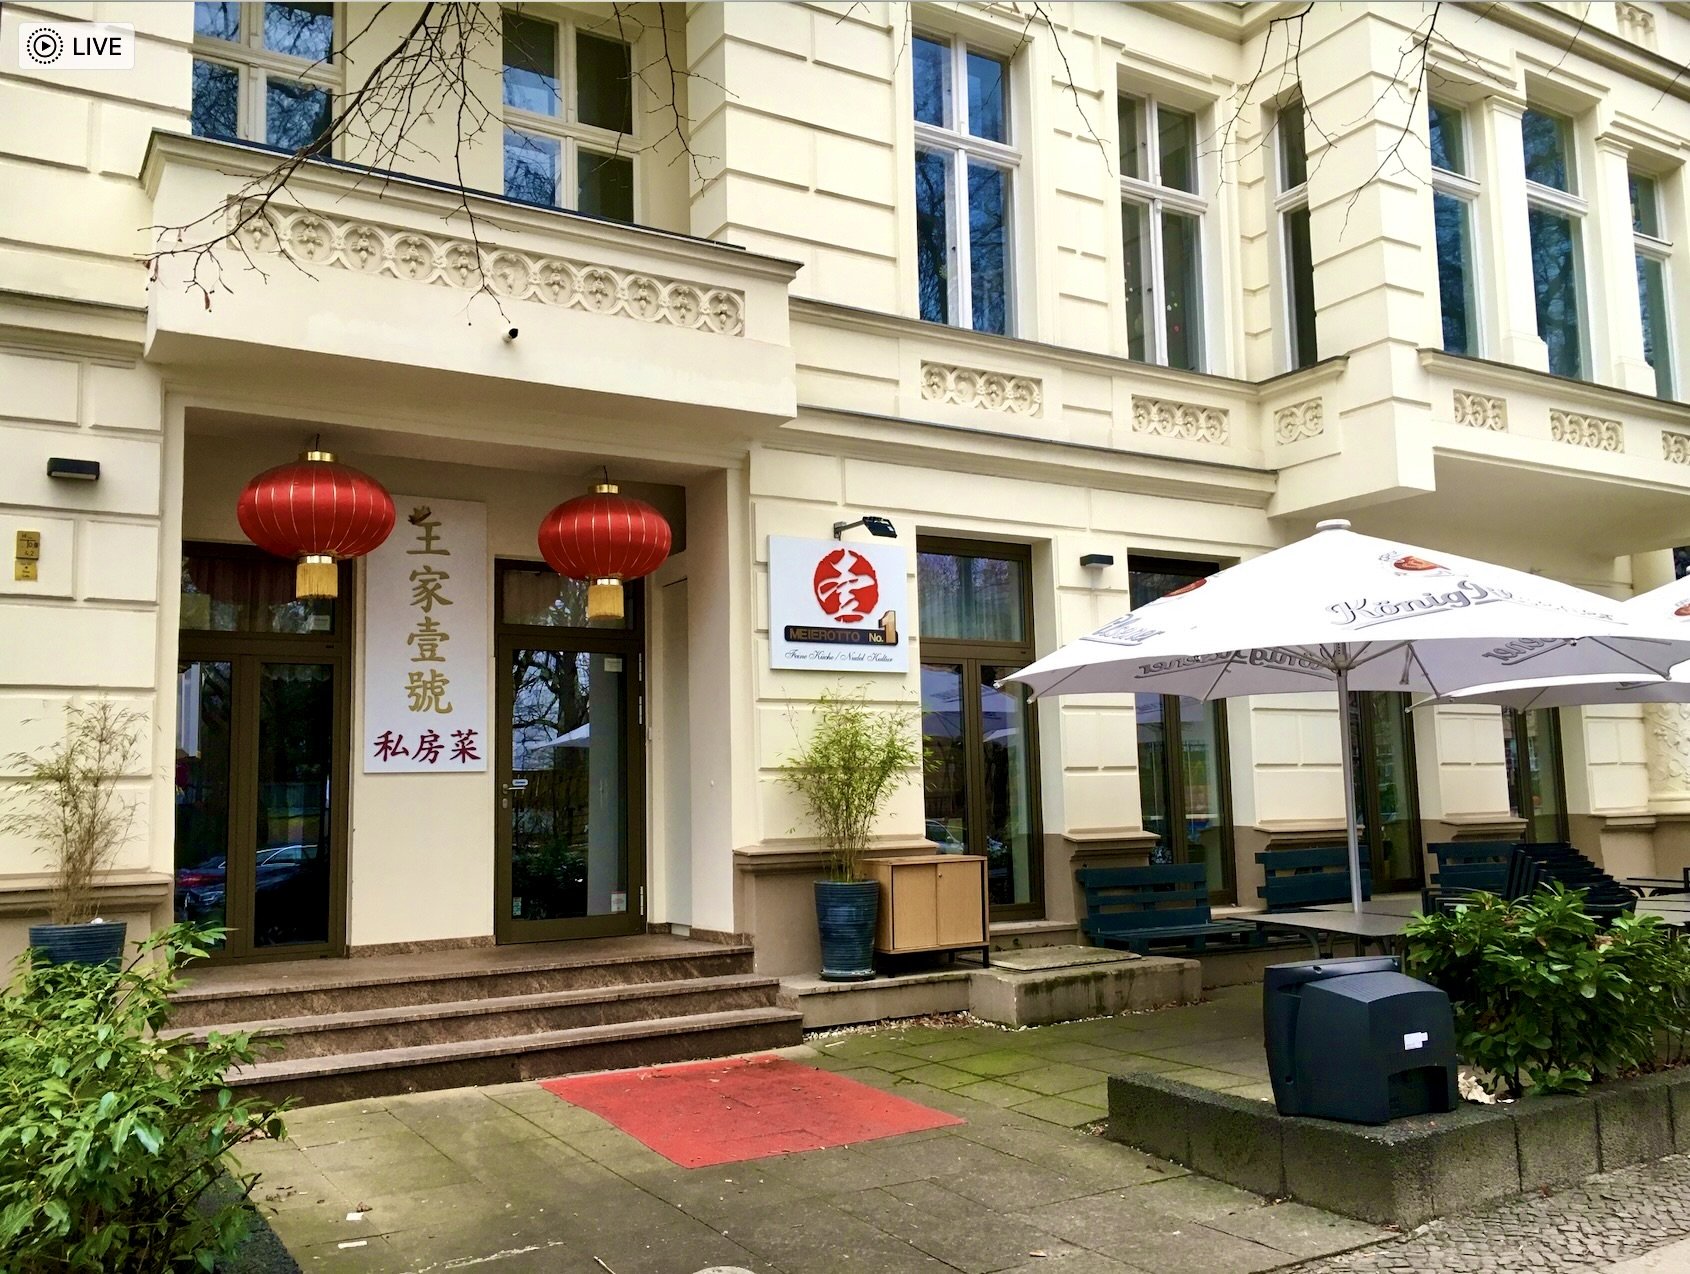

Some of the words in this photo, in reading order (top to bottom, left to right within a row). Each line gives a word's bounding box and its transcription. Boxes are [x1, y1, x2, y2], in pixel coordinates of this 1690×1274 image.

[789, 627, 860, 642] MEIEROTTO
[373, 728, 482, 764] 私房菜
